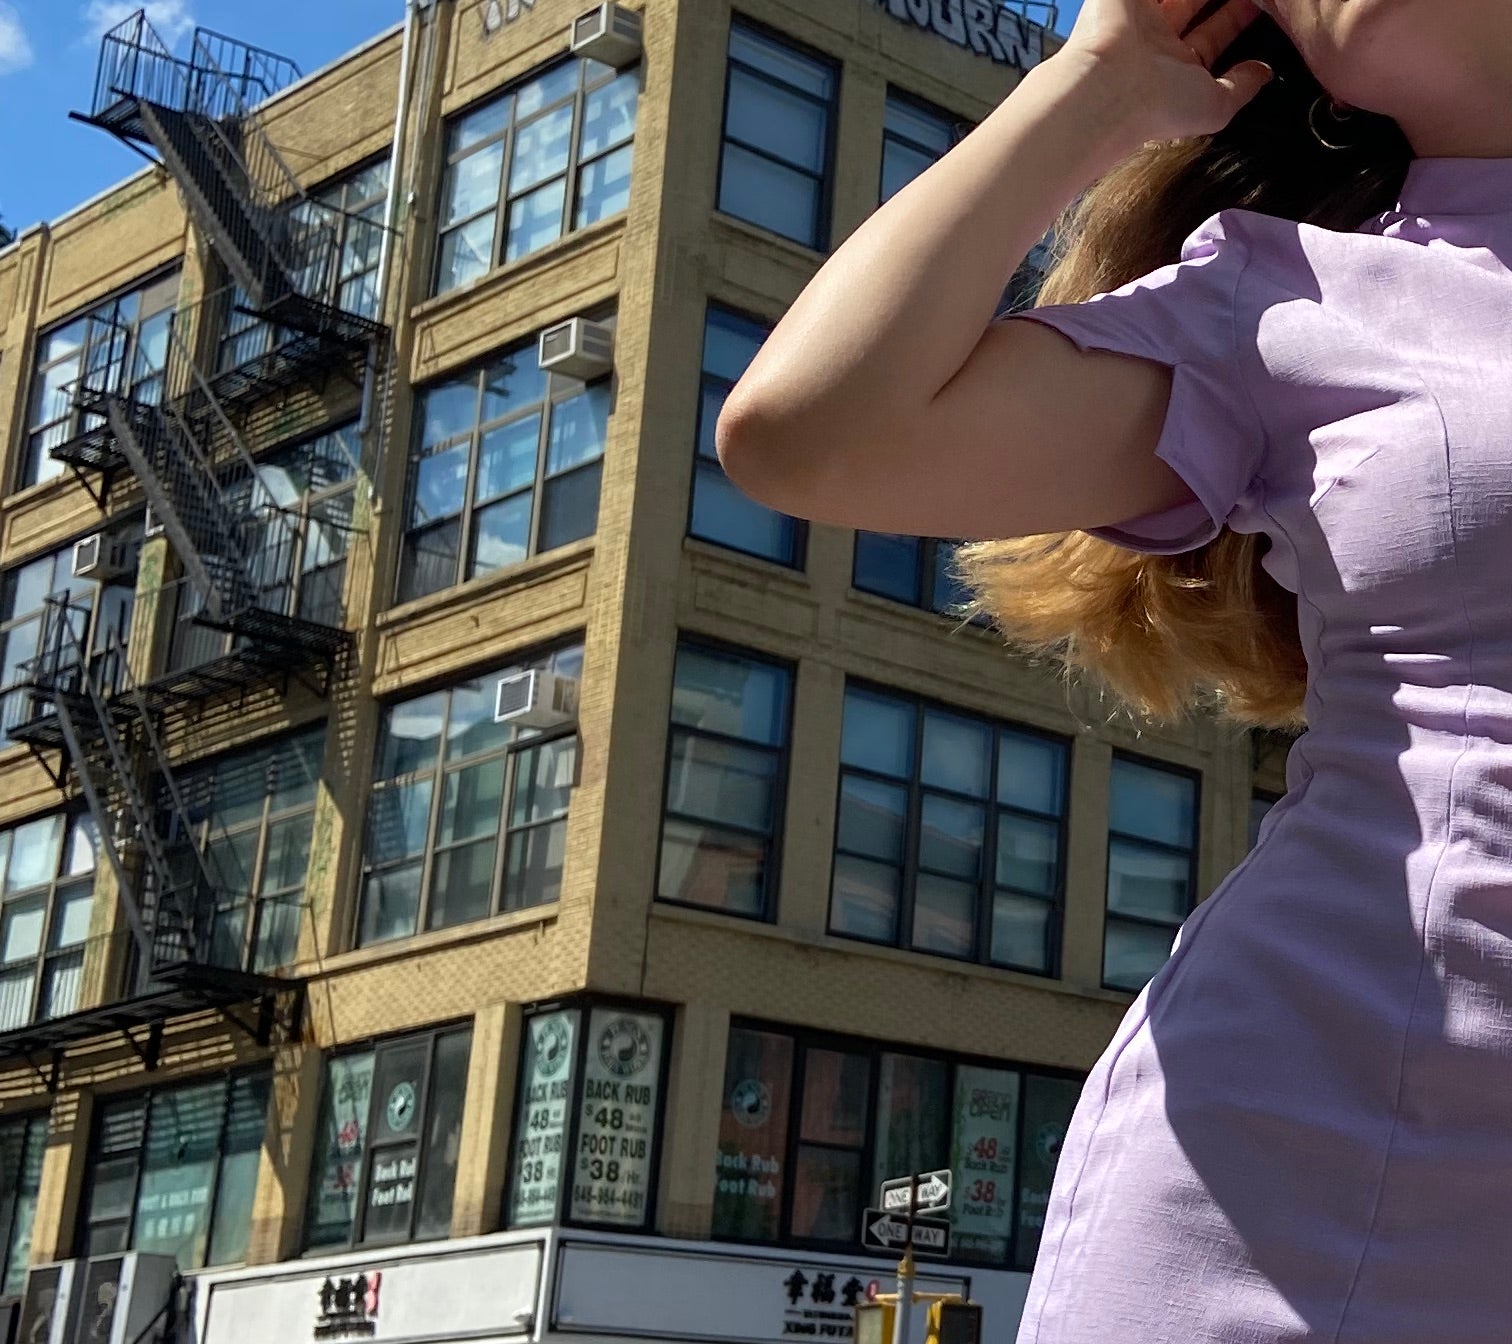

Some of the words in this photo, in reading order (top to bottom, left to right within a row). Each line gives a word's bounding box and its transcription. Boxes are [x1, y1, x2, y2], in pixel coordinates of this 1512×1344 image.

[586, 1078, 620, 1102] BACK
[625, 1084, 651, 1106] RUB
[581, 1133, 617, 1157] FOOT
[620, 1137, 647, 1159] RUB
[921, 1183, 941, 1200] WAY
[877, 1221, 904, 1239] ONE
[912, 1226, 939, 1244] WAY
